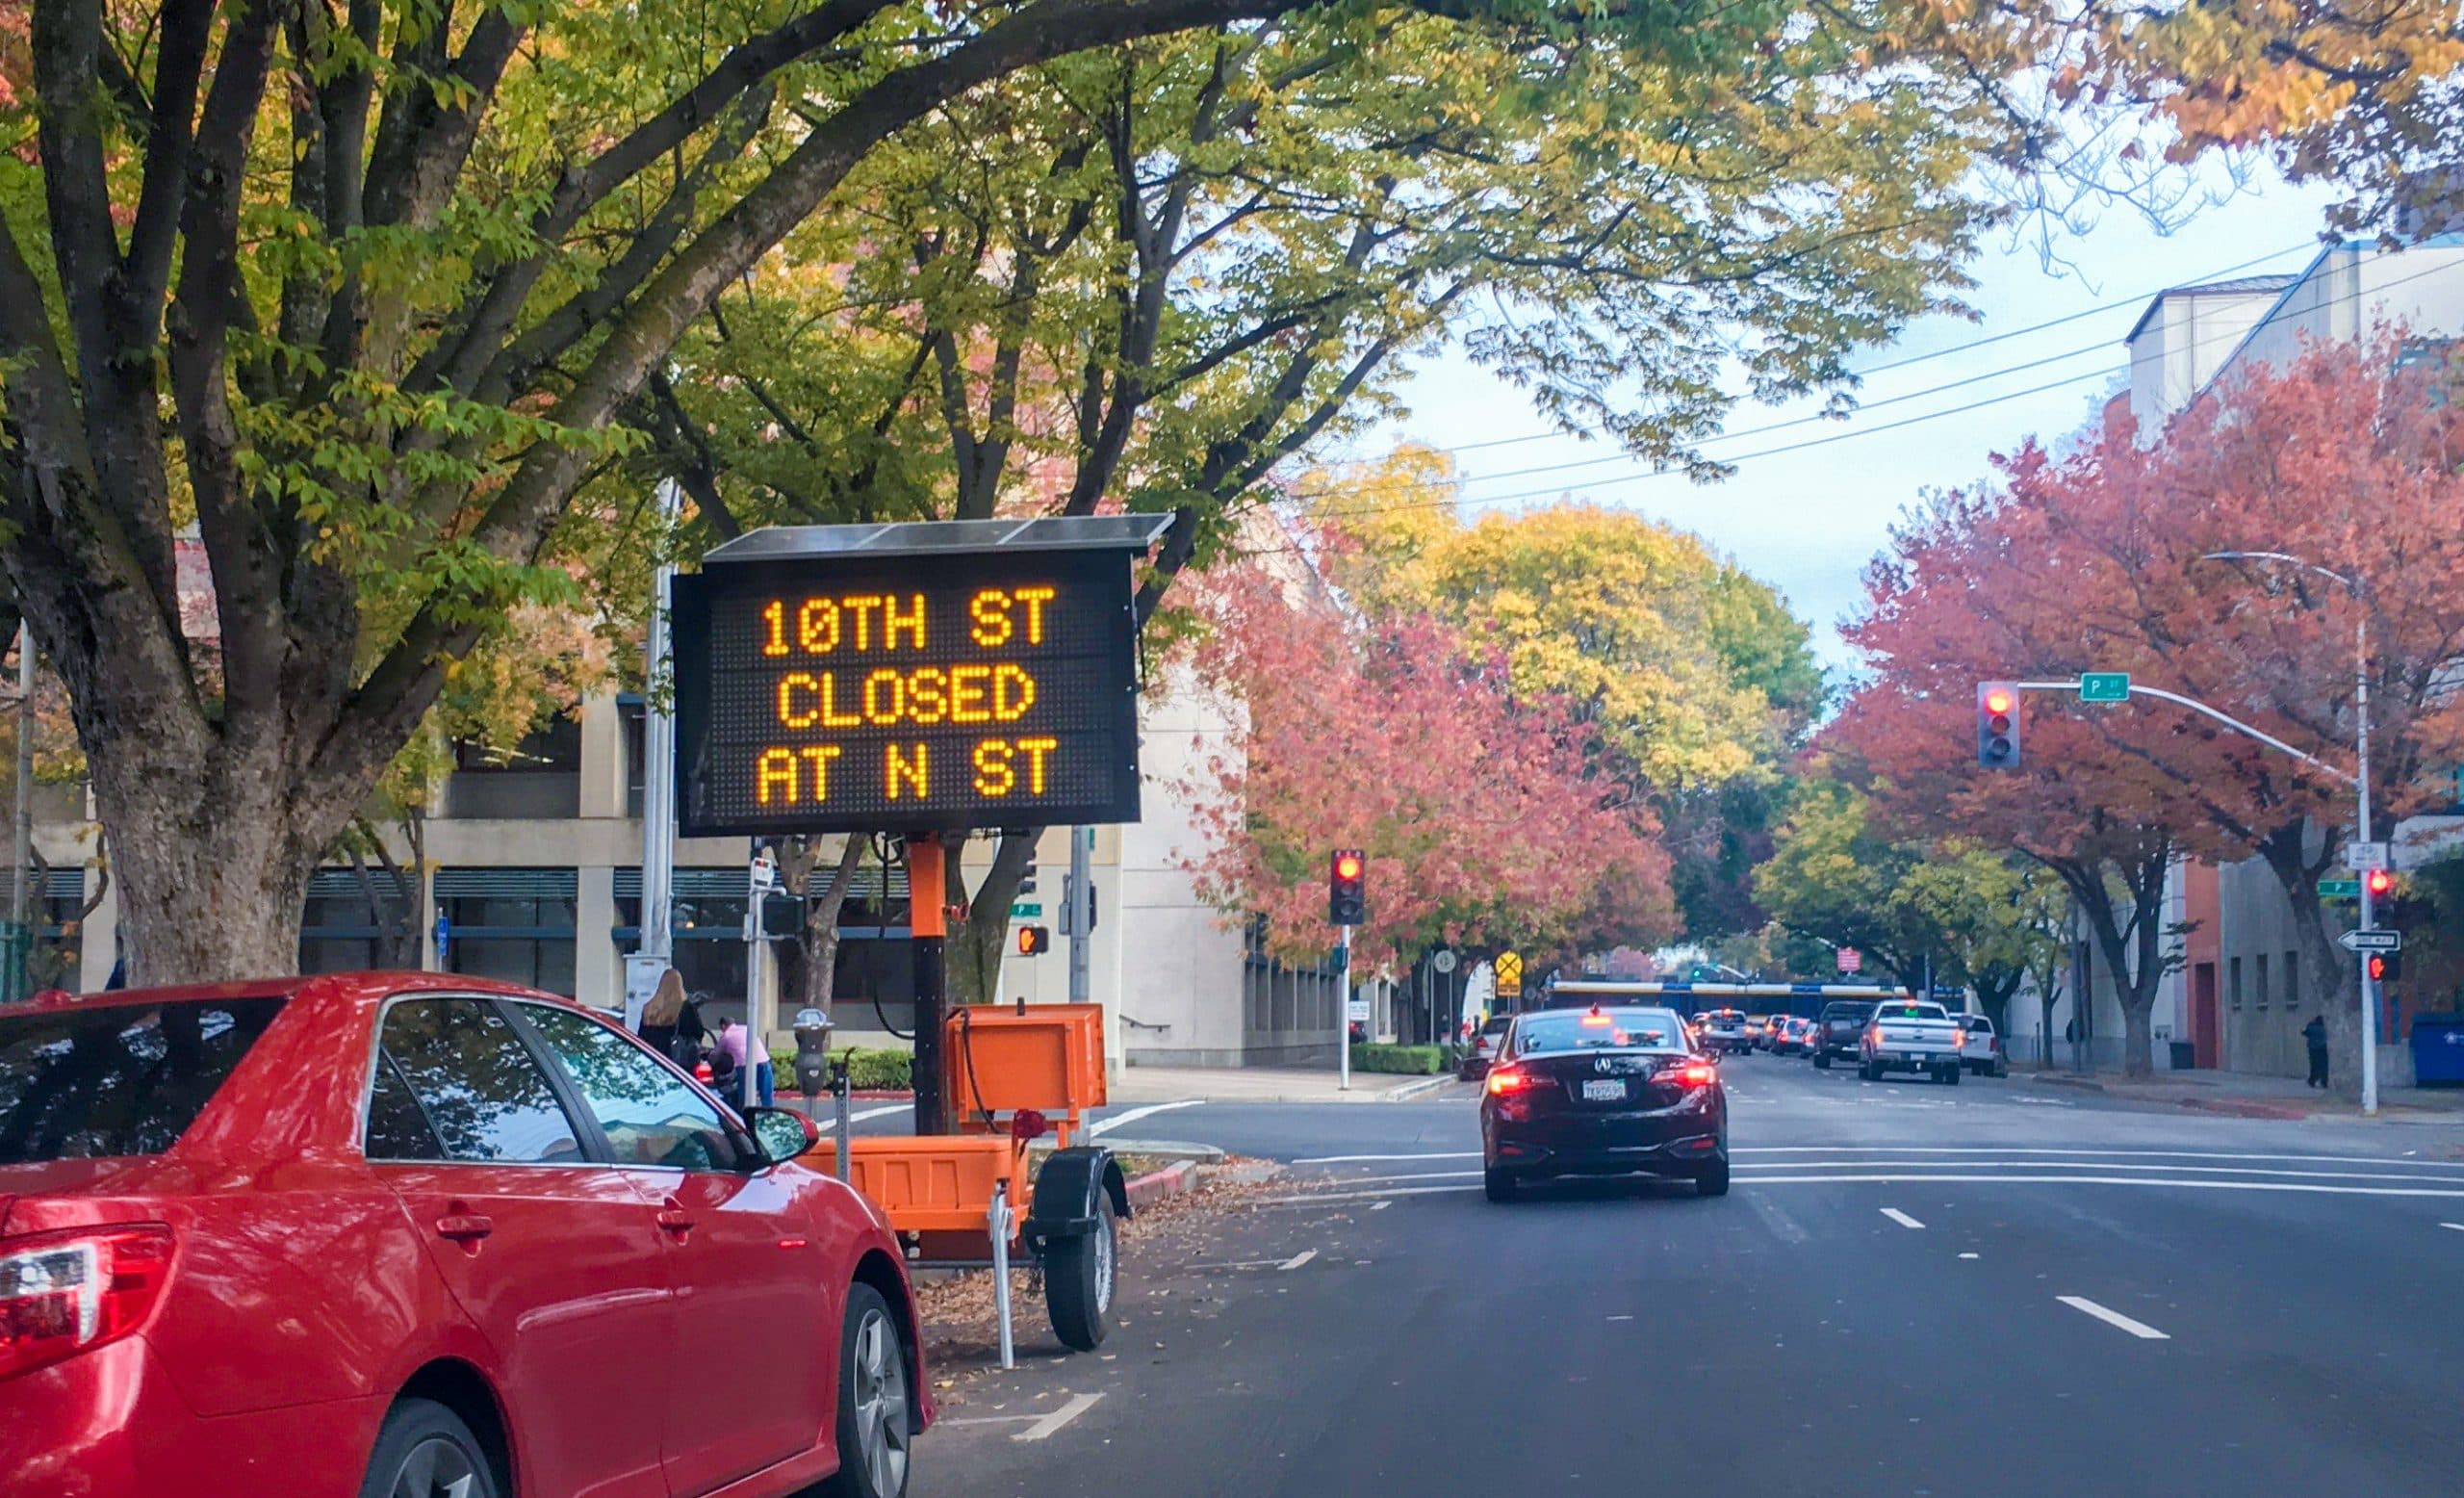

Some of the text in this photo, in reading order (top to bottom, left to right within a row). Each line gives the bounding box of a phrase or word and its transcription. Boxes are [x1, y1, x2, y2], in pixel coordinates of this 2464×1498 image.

[762, 585, 1056, 657] 10TH ST
[778, 662, 1036, 729] CLOSED
[2092, 680, 2101, 693] P
[757, 736, 1058, 805] AT N ST
